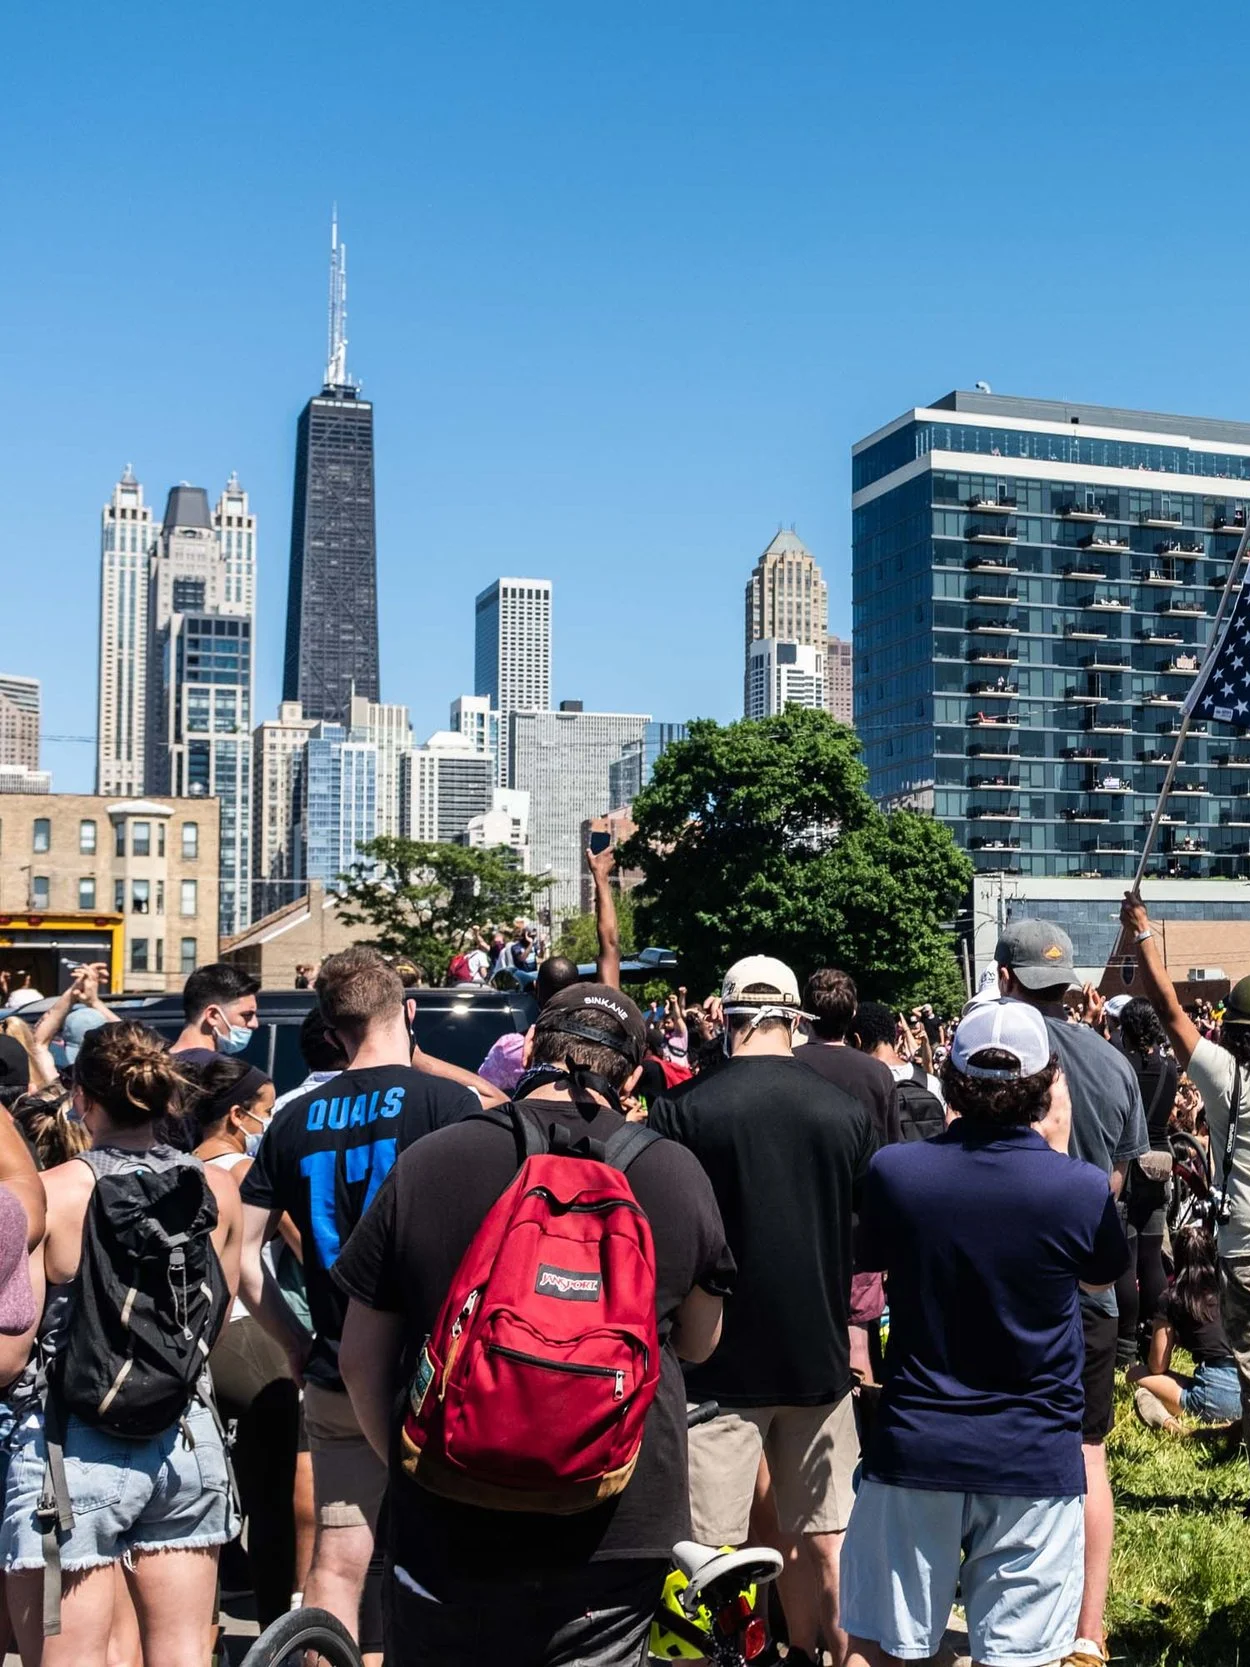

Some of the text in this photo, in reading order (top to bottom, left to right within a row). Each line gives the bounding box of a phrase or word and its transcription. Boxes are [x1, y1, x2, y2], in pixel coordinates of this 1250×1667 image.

[583, 996, 629, 1021] SINKANE
[306, 1086, 406, 1132] QUALS
[300, 1137, 397, 1270] 17
[539, 1271, 599, 1293] JANSPORT
